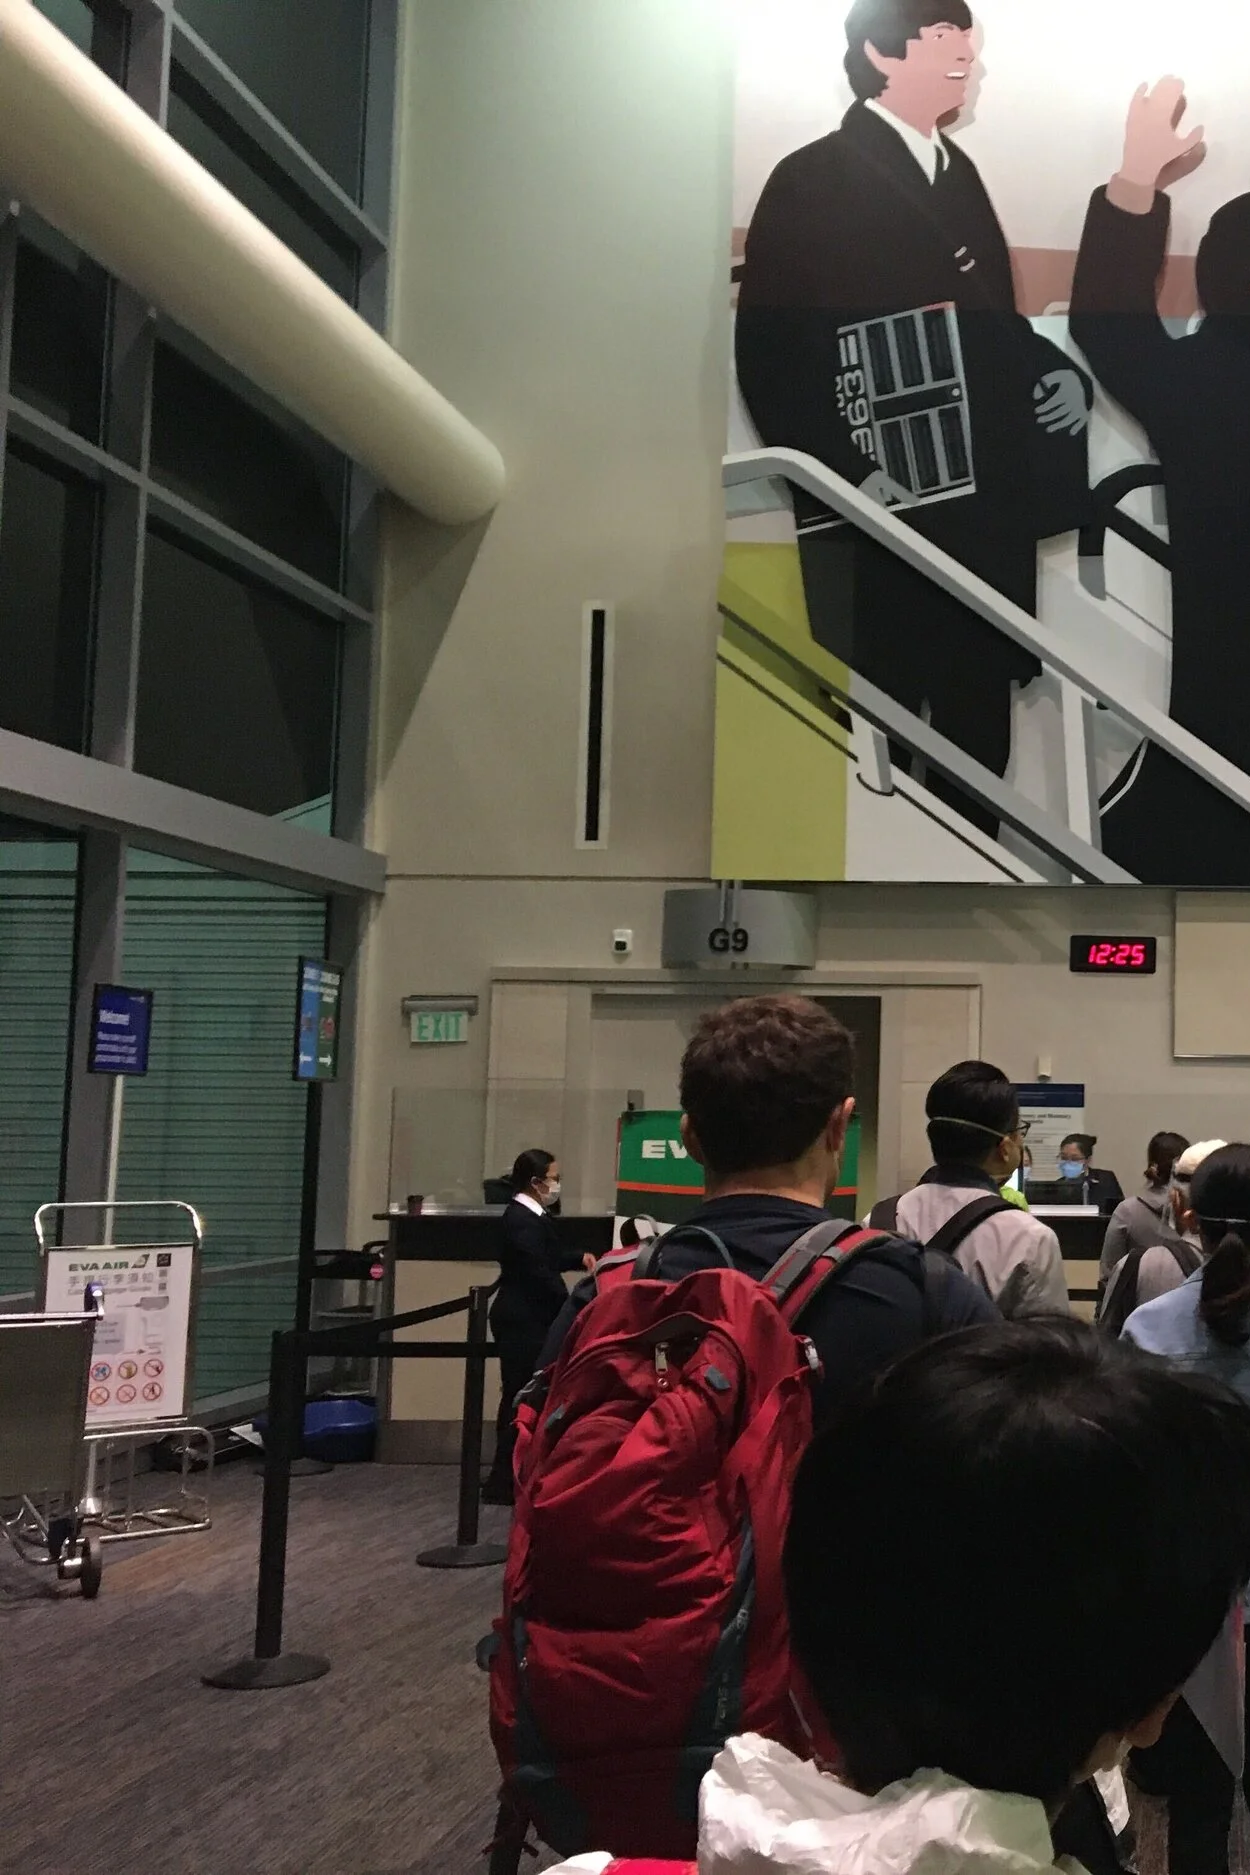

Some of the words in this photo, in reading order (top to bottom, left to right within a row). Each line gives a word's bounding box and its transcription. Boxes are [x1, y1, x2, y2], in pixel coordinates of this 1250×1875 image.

[708, 927, 749, 952] G9
[1088, 943, 1146, 966] 12:25
[417, 1012, 463, 1041] EXIT
[641, 1139, 688, 1159] EV
[68, 1263, 100, 1272] EVA
[102, 1261, 129, 1270] AIR
